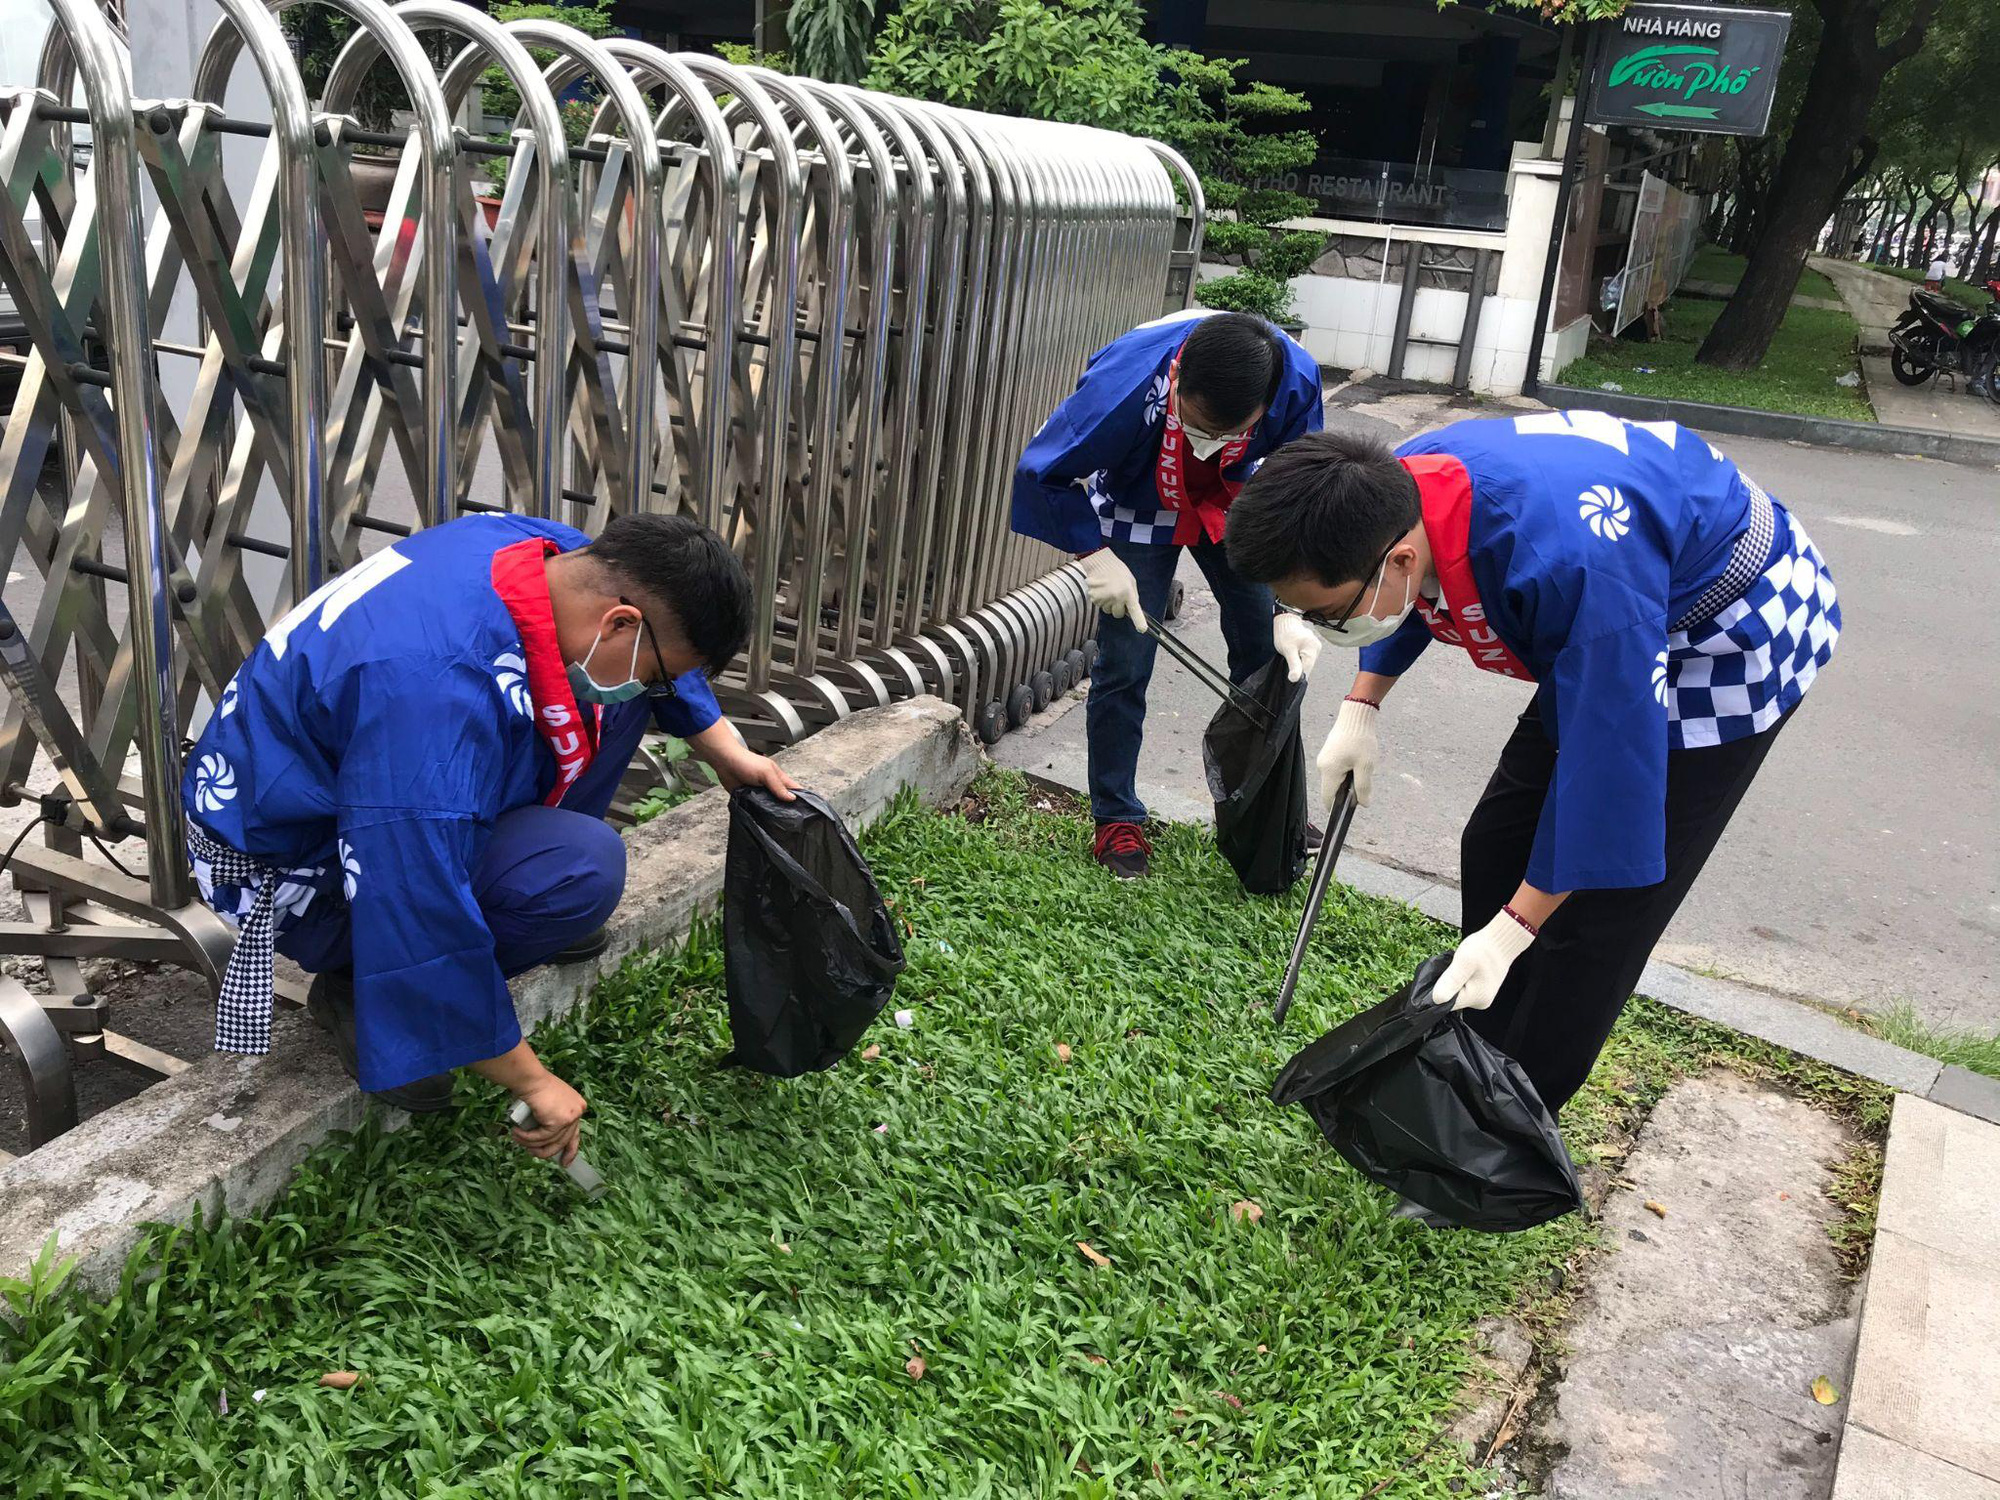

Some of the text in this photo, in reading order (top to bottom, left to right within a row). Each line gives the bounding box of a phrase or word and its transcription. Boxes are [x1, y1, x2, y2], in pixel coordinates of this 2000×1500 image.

[1622, 16, 1722, 39] NHÀ HÀNG
[1683, 61, 1762, 101] Phố
[1307, 173, 1449, 206] RESTAURANT
